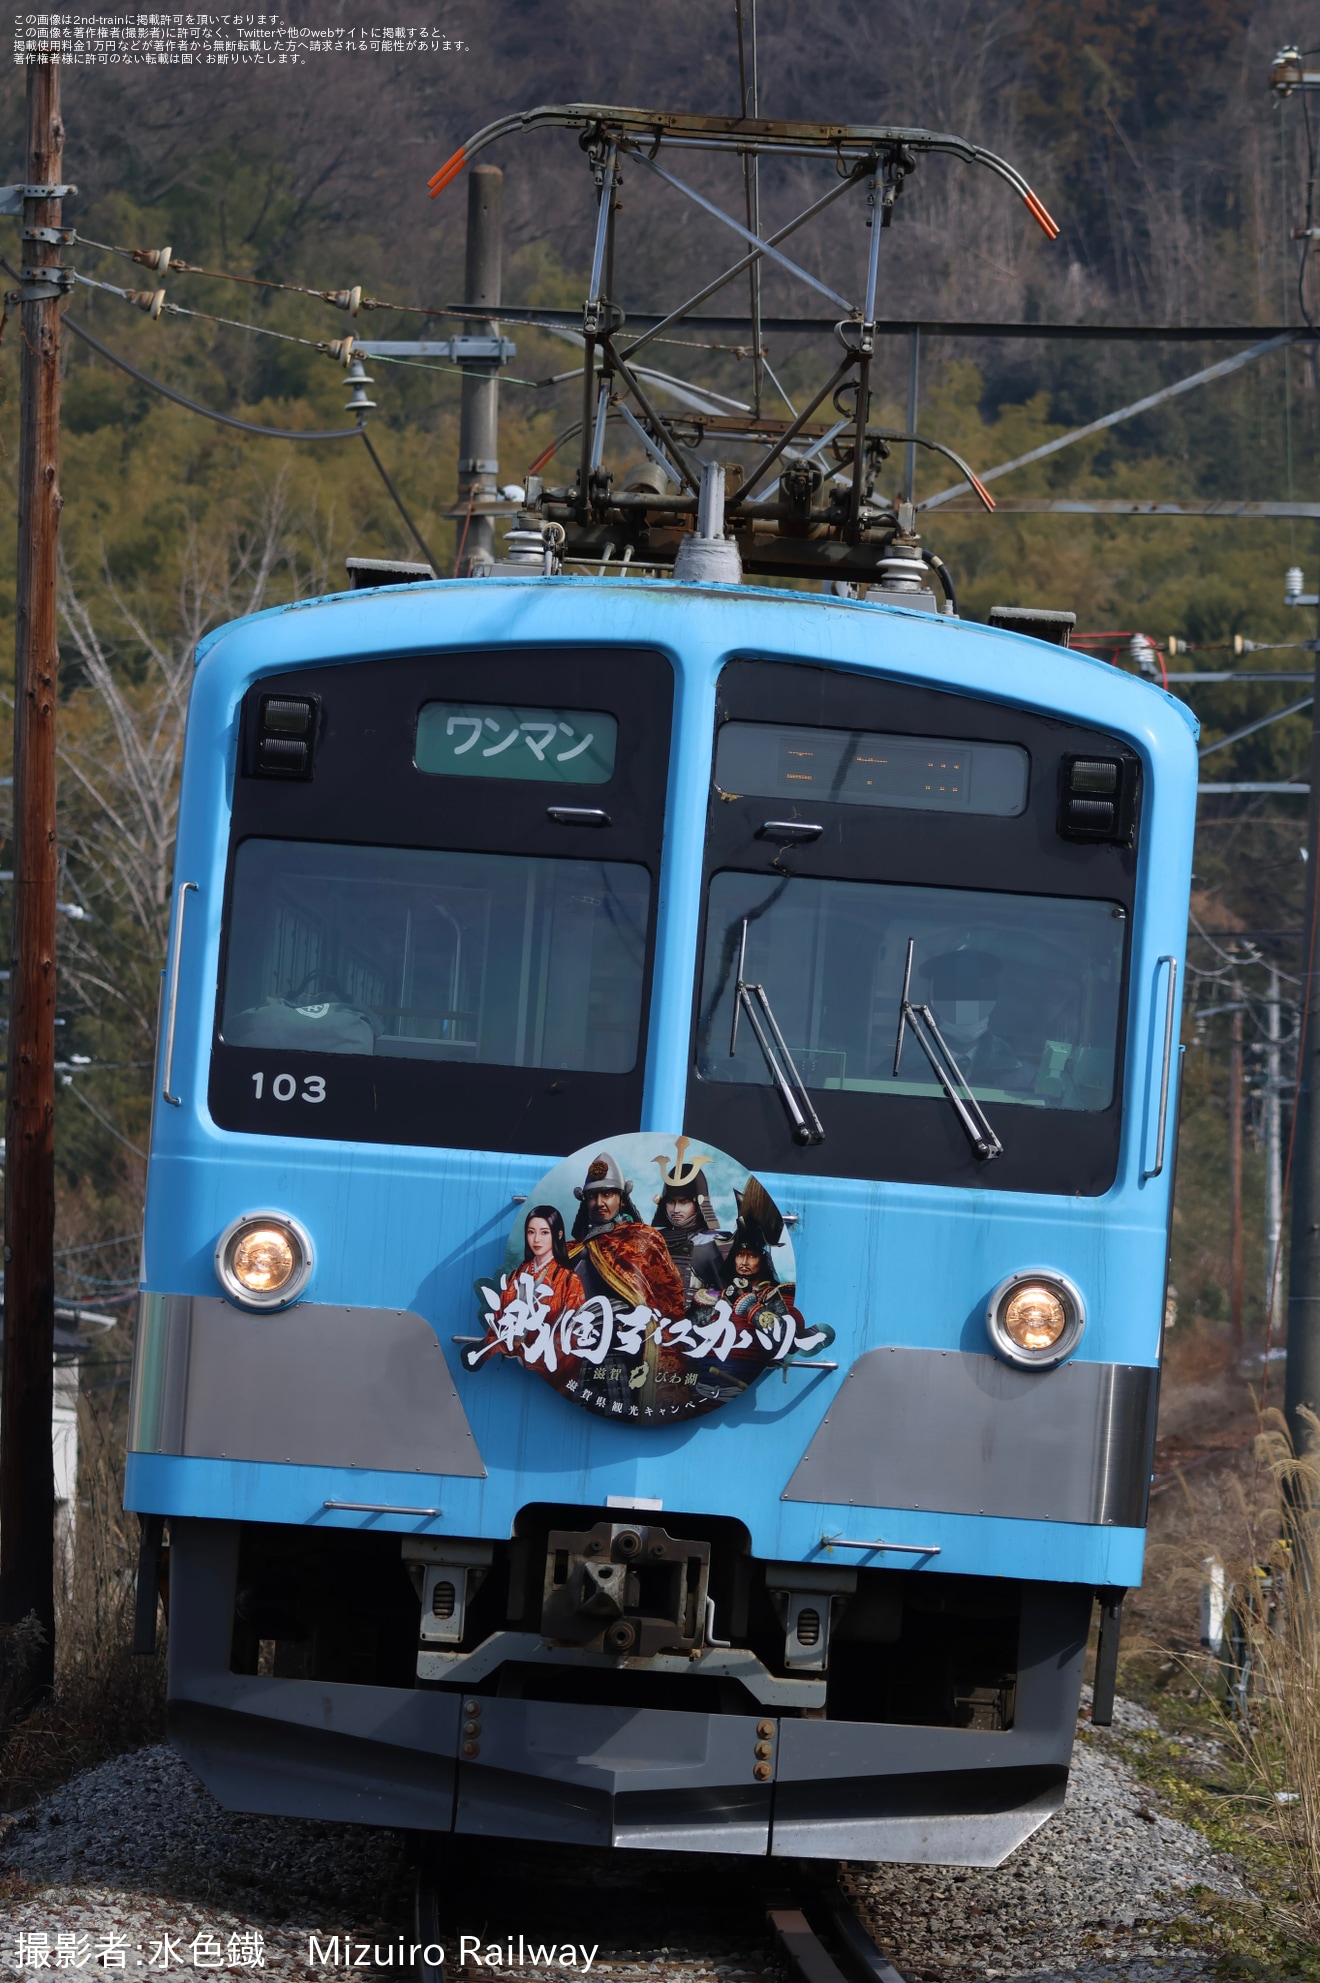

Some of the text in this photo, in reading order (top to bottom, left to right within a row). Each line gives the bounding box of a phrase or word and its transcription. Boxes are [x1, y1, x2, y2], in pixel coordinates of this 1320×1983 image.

[446, 716, 594, 761] ワンマン
[252, 1072, 326, 1104] 103
[467, 1273, 828, 1373] 戦国ディスカバリー
[592, 1367, 699, 1386] 滋賀 びわ湖
[565, 1378, 720, 1417] 滋賀県観光キャンペーン
